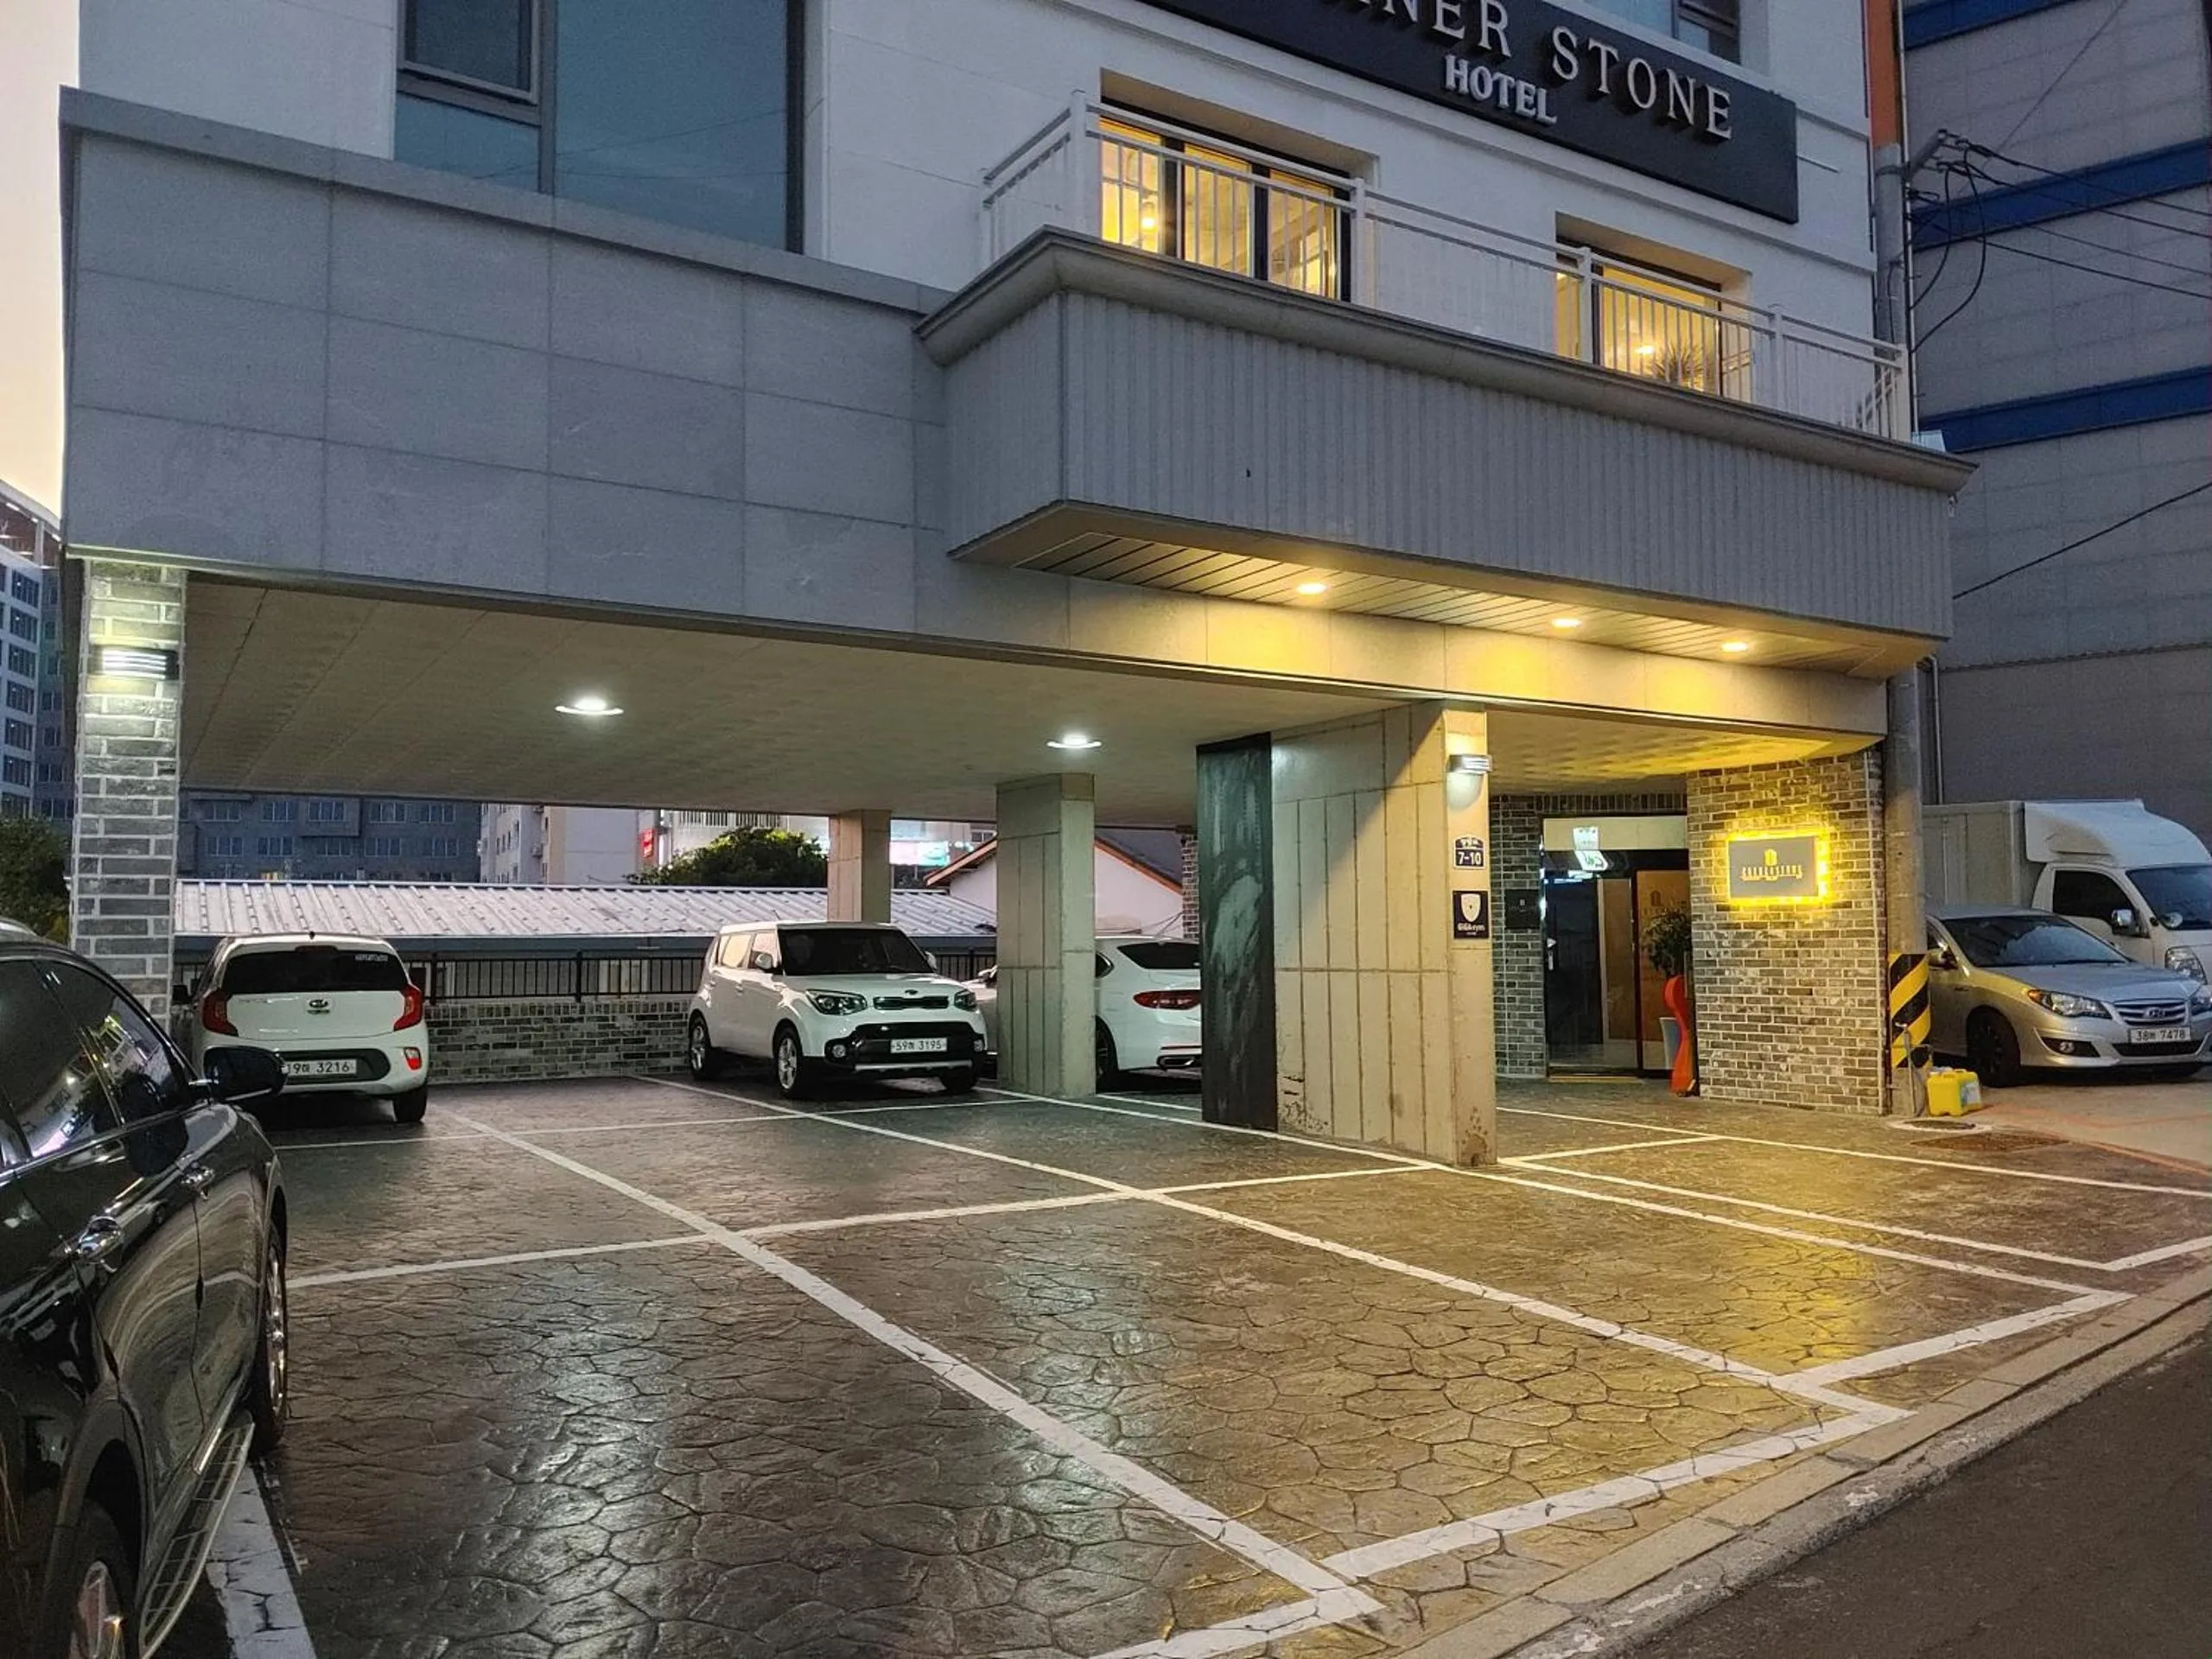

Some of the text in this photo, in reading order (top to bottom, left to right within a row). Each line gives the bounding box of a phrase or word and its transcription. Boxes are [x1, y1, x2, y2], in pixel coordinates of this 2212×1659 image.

[1444, 53, 1559, 125] HOTEL
[1549, 25, 1733, 140] STONE
[1458, 851, 1482, 865] 7-10
[316, 1061, 350, 1073] 3216
